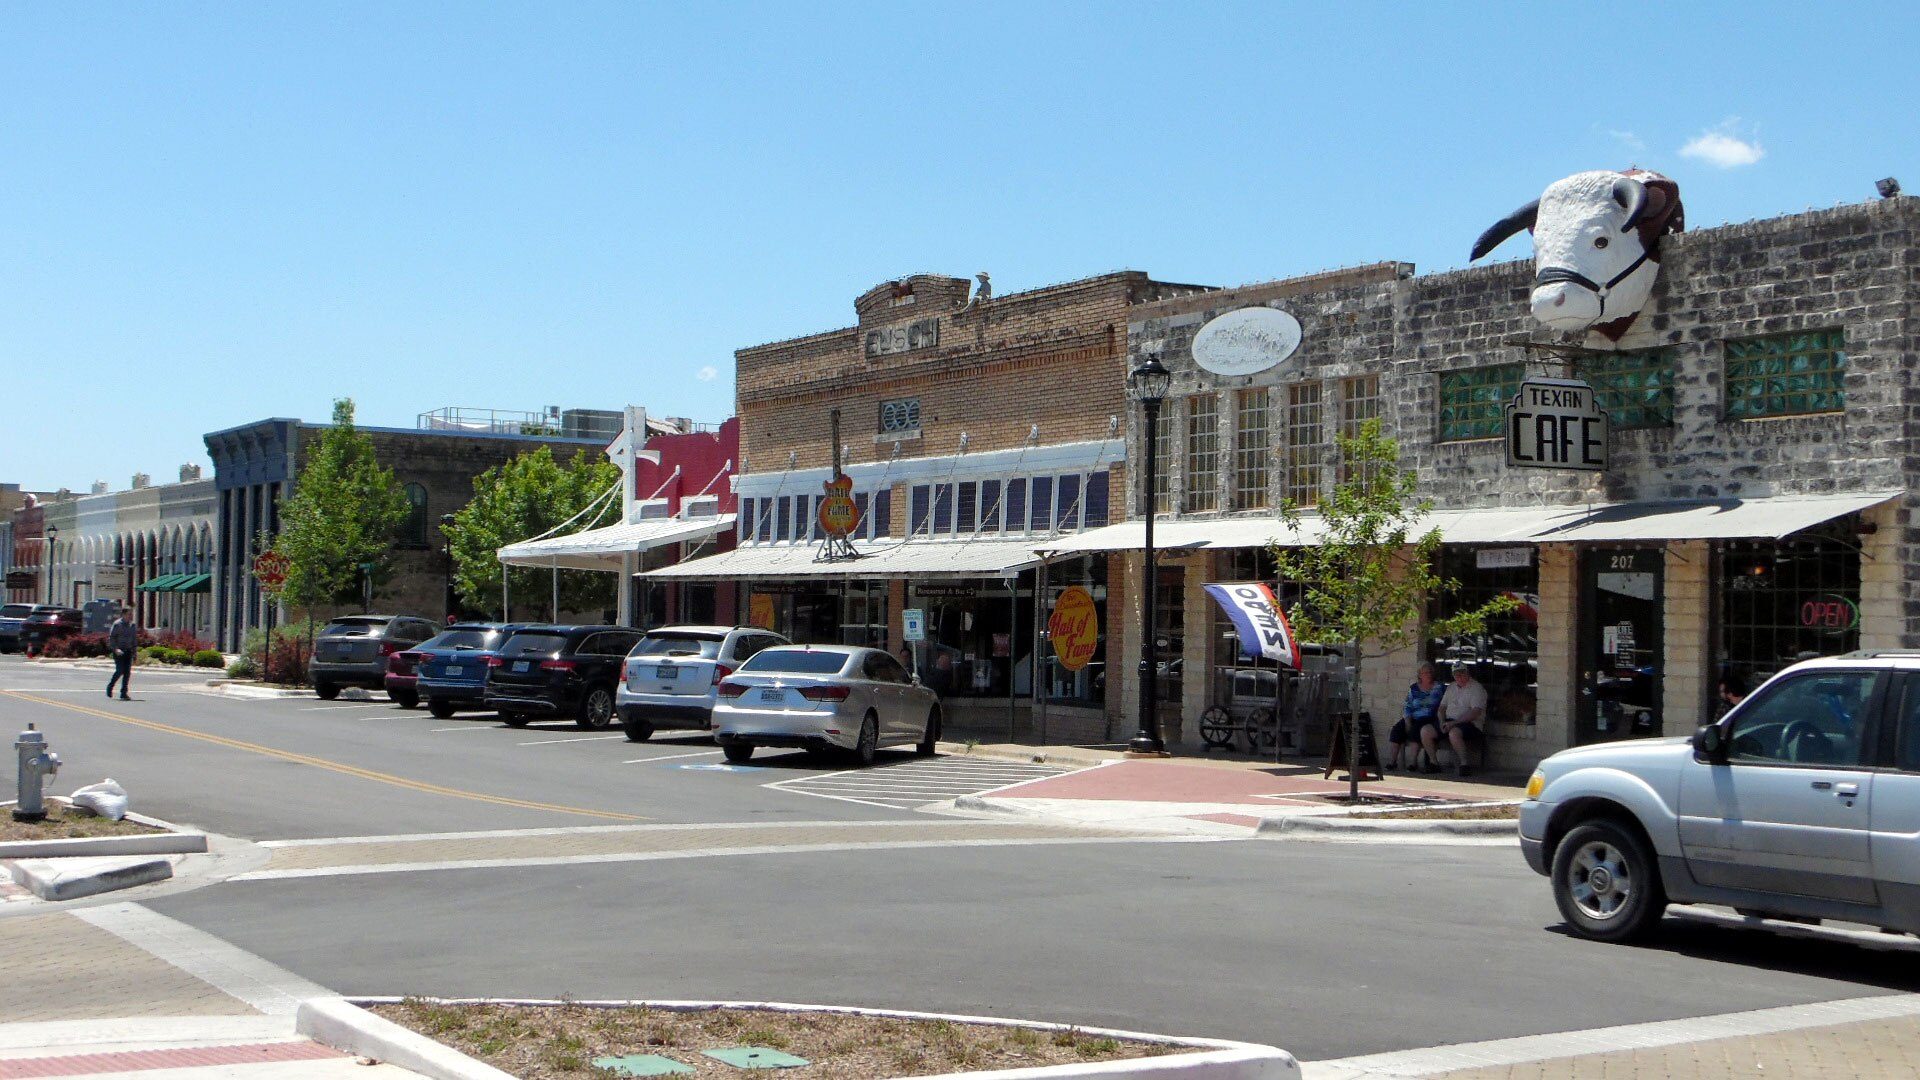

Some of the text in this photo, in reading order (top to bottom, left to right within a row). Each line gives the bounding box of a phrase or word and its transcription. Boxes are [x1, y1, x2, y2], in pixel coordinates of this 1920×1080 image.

[866, 319, 939, 356] BUSCH
[1529, 387, 1582, 408] TEXAN
[1512, 412, 1603, 464] CAFE
[827, 505, 850, 516] FAME
[1504, 550, 1526, 564] Shop
[1611, 555, 1634, 569] 207
[1049, 611, 1091, 639] Hall of
[1801, 601, 1849, 627] OPEN
[1065, 633, 1096, 659] Fame
